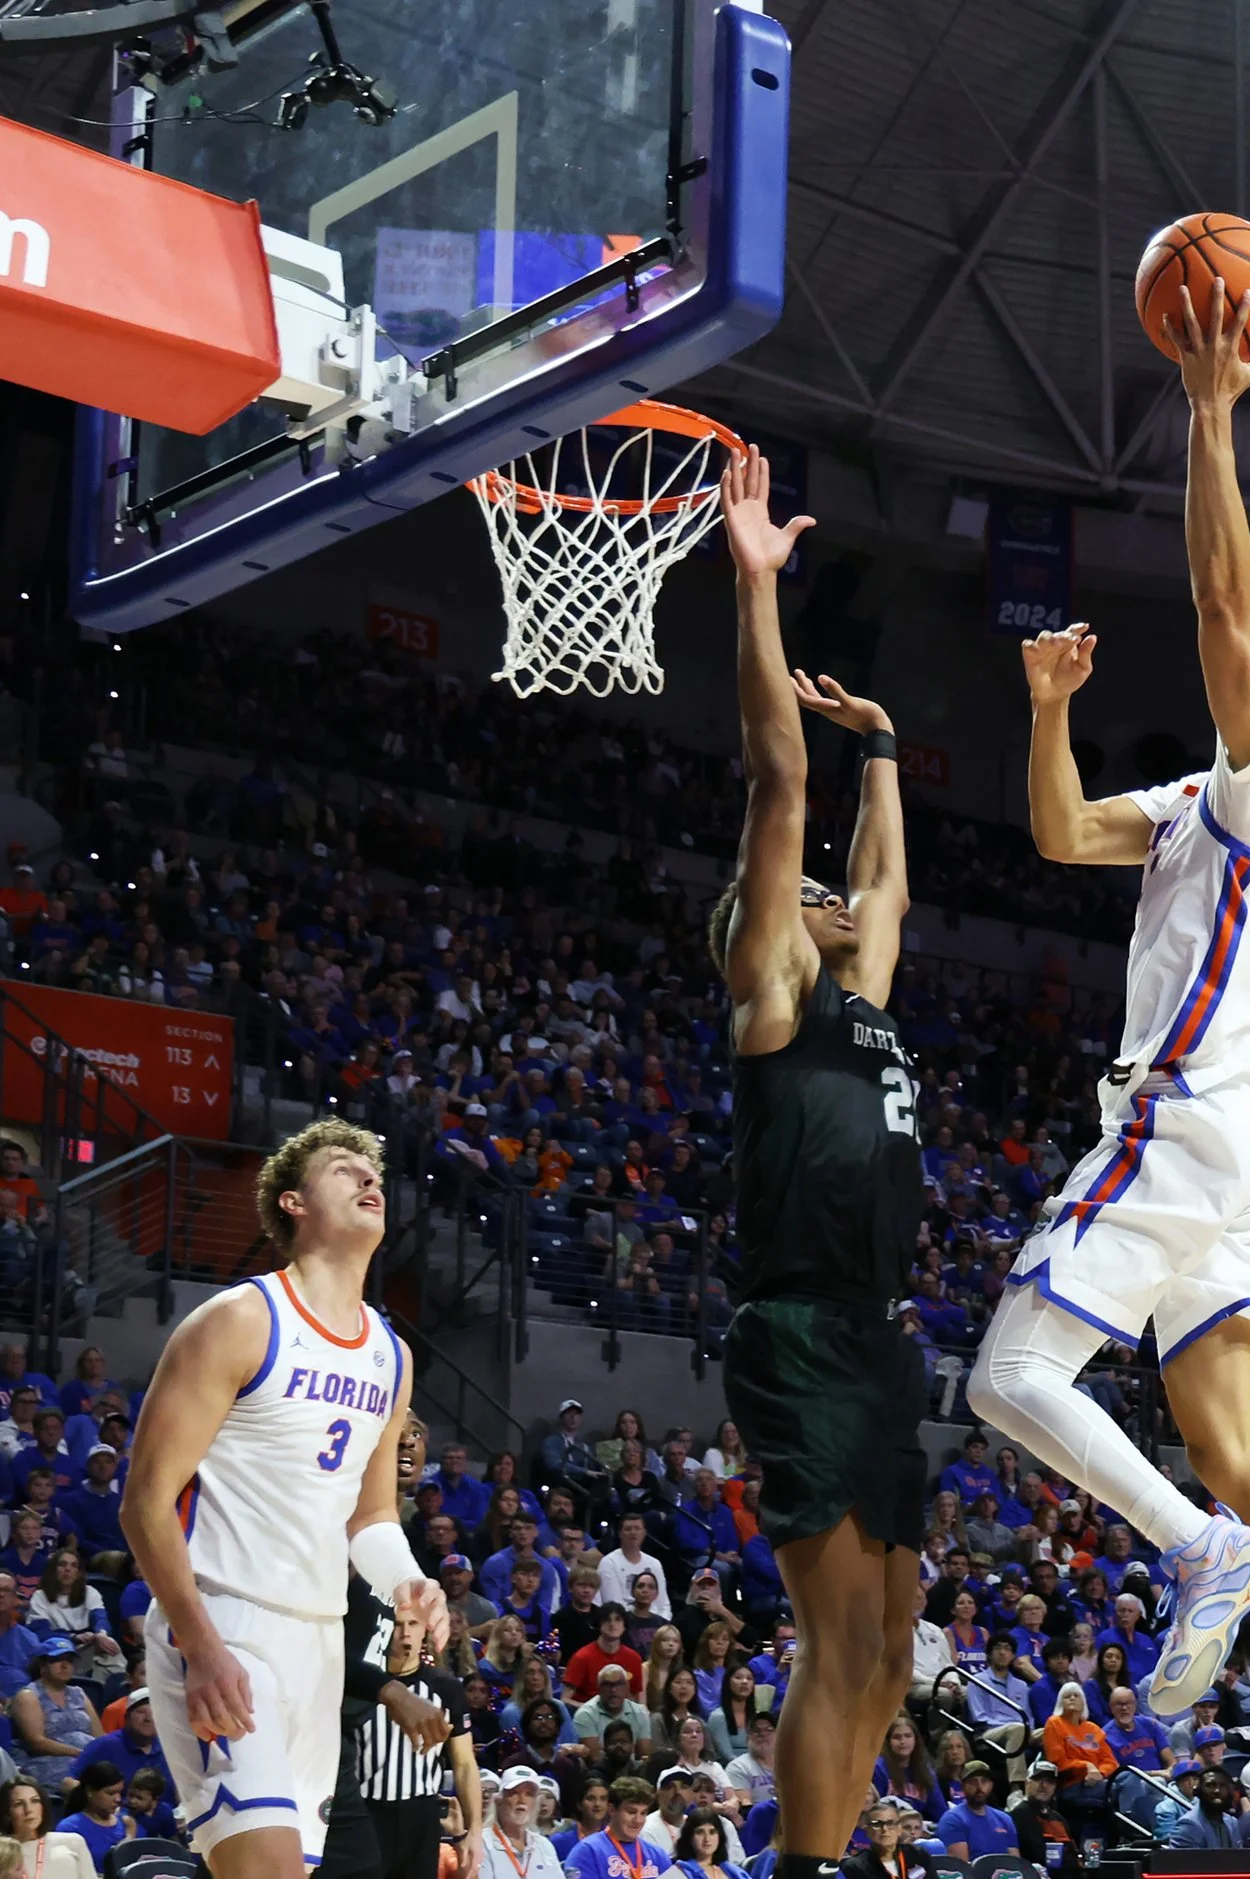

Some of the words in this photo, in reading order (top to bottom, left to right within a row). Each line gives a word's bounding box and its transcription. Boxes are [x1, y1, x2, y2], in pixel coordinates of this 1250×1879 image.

[999, 601, 1062, 630] 2024
[901, 748, 942, 778] 214
[165, 1024, 223, 1043] SECTION
[166, 1046, 193, 1065] 113
[172, 1085, 191, 1104] 13
[282, 1366, 389, 1420] FLORIDA
[316, 1417, 353, 1472] 3
